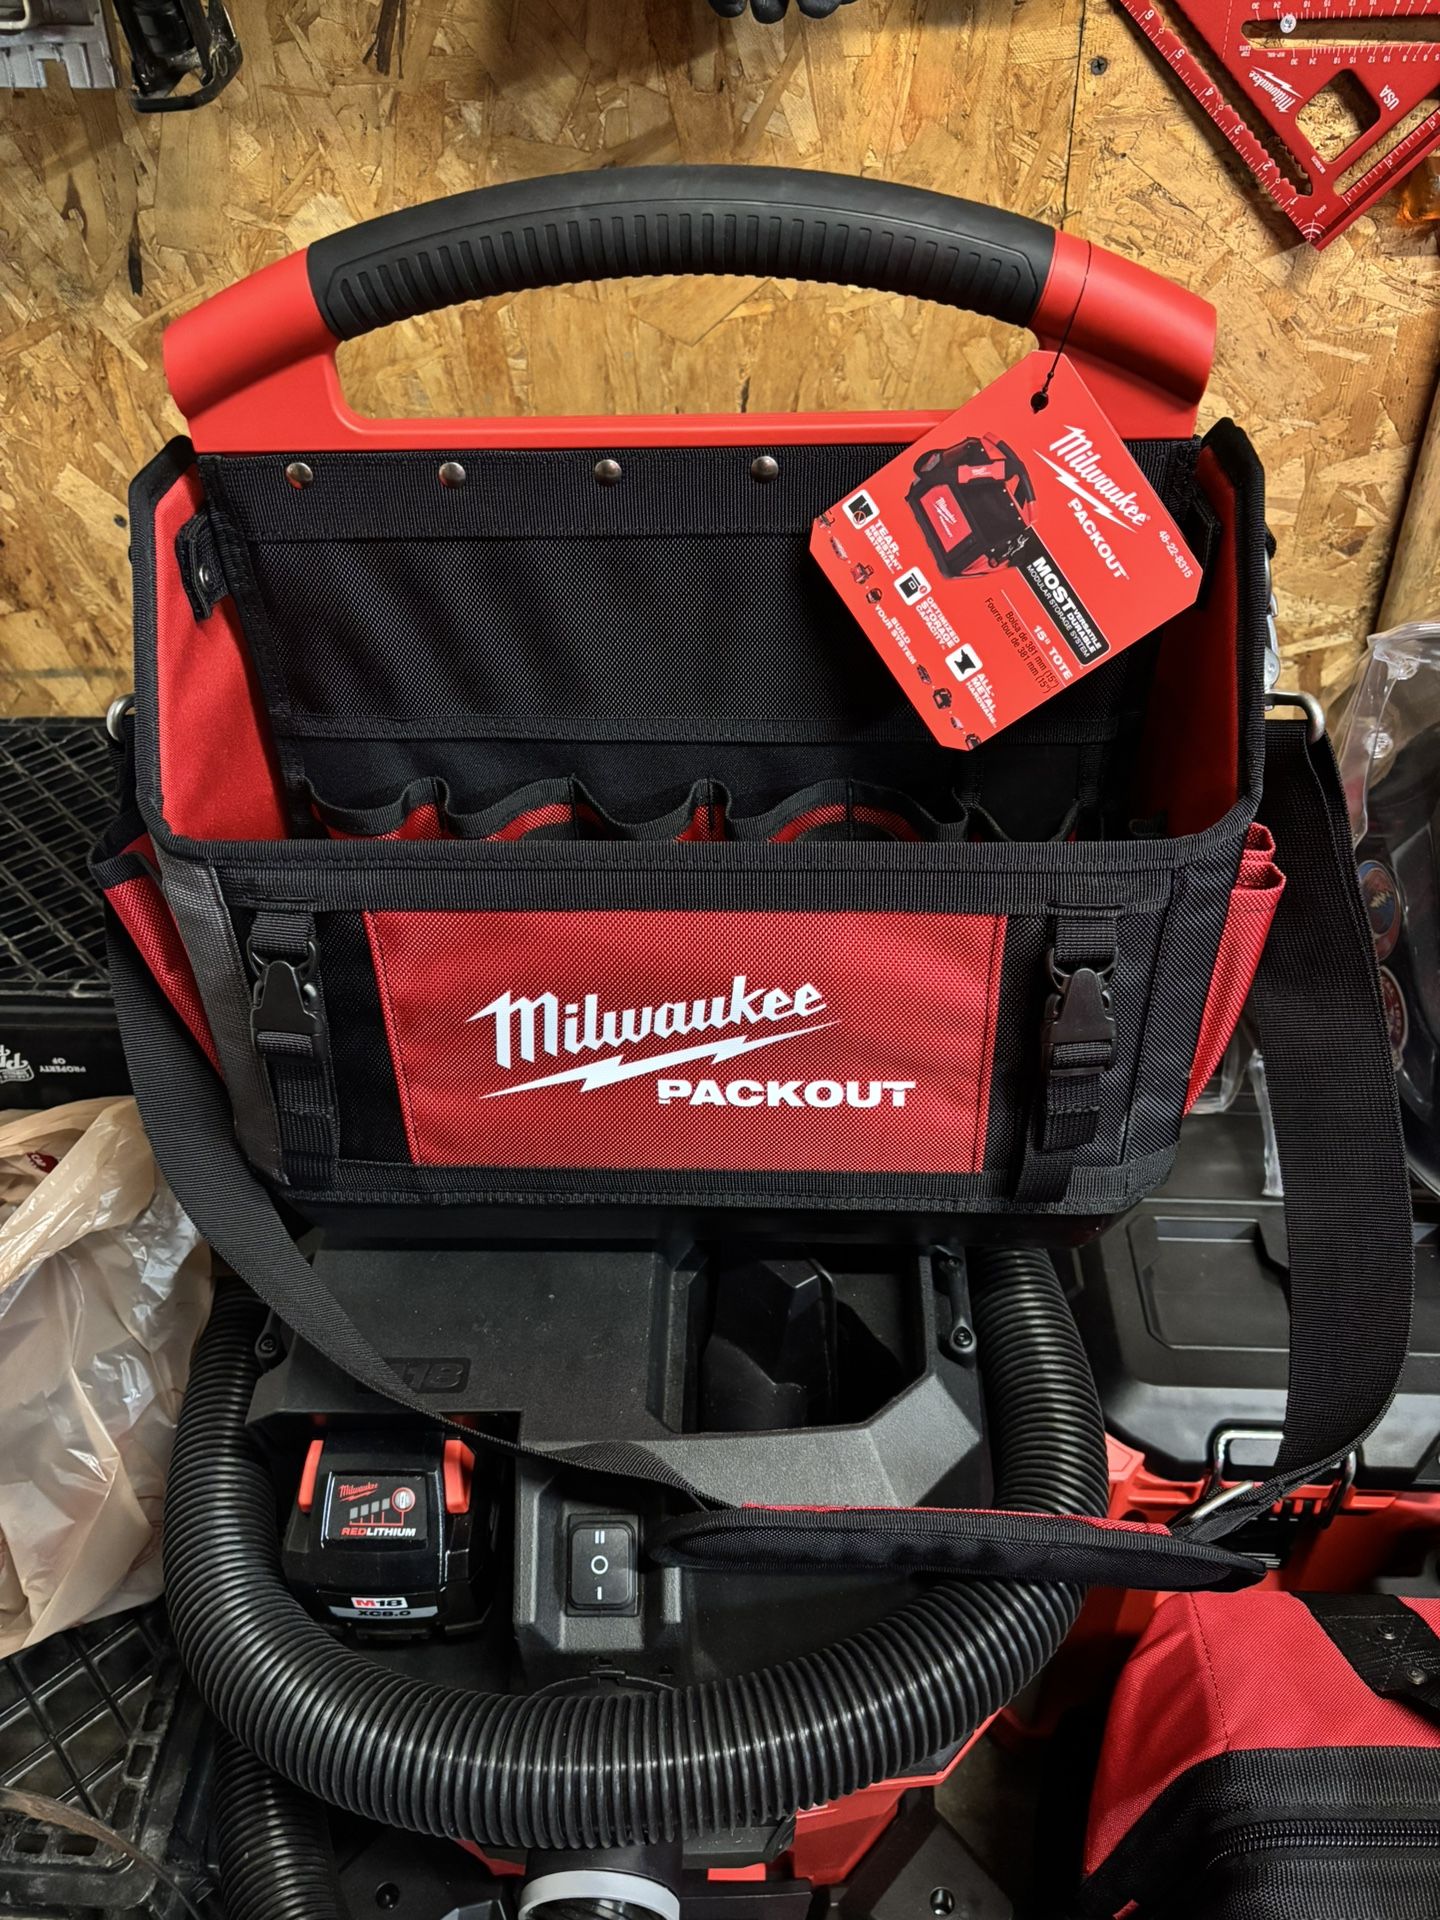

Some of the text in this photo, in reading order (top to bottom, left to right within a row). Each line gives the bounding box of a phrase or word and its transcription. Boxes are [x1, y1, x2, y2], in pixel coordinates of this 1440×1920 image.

[1175, 48, 1185, 60] 5
[1205, 87, 1214, 96] 4
[1248, 70, 1296, 113] Milwaukee
[1379, 84, 1400, 111] USA
[1234, 124, 1244, 135] 3
[1262, 161, 1272, 171] 2
[1048, 425, 1147, 525] Milwaukee
[868, 524, 902, 571] RESISTANT
[874, 519, 902, 557] TEAR-
[1066, 497, 1126, 581] PACKOUT
[1156, 528, 1194, 579] 48-22-8315
[926, 596, 960, 644] OPTIMIZED
[1026, 564, 1090, 657] MODULAR STORAGE SYSTEM
[1031, 555, 1101, 649] MOST VERSATILE
[874, 604, 916, 664] YOUR SYSTEM
[890, 616, 911, 643] BUILD
[920, 600, 955, 648] STORAGE
[984, 597, 1014, 638] Fourre-tout
[1009, 636, 1020, 648] de
[1016, 646, 1029, 661] 381
[1026, 661, 1038, 676] mm
[1005, 611, 1022, 632] Bolsa
[1018, 631, 1029, 642] de
[1024, 641, 1037, 655] 381
[1034, 655, 1046, 670] mm
[1066, 612, 1096, 653] DURABLE
[1047, 646, 1073, 680] TOTE
[971, 677, 997, 712] METAL
[977, 672, 996, 697] ALL-
[465, 975, 827, 1070] Milwaukee
[39, 1065, 87, 1073] PROPERTY
[657, 1079, 916, 1108] PACKOUT
[339, 1481, 379, 1498] Milwaukee
[341, 1527, 416, 1537] REDLITHIUM
[354, 1598, 405, 1607] M18
